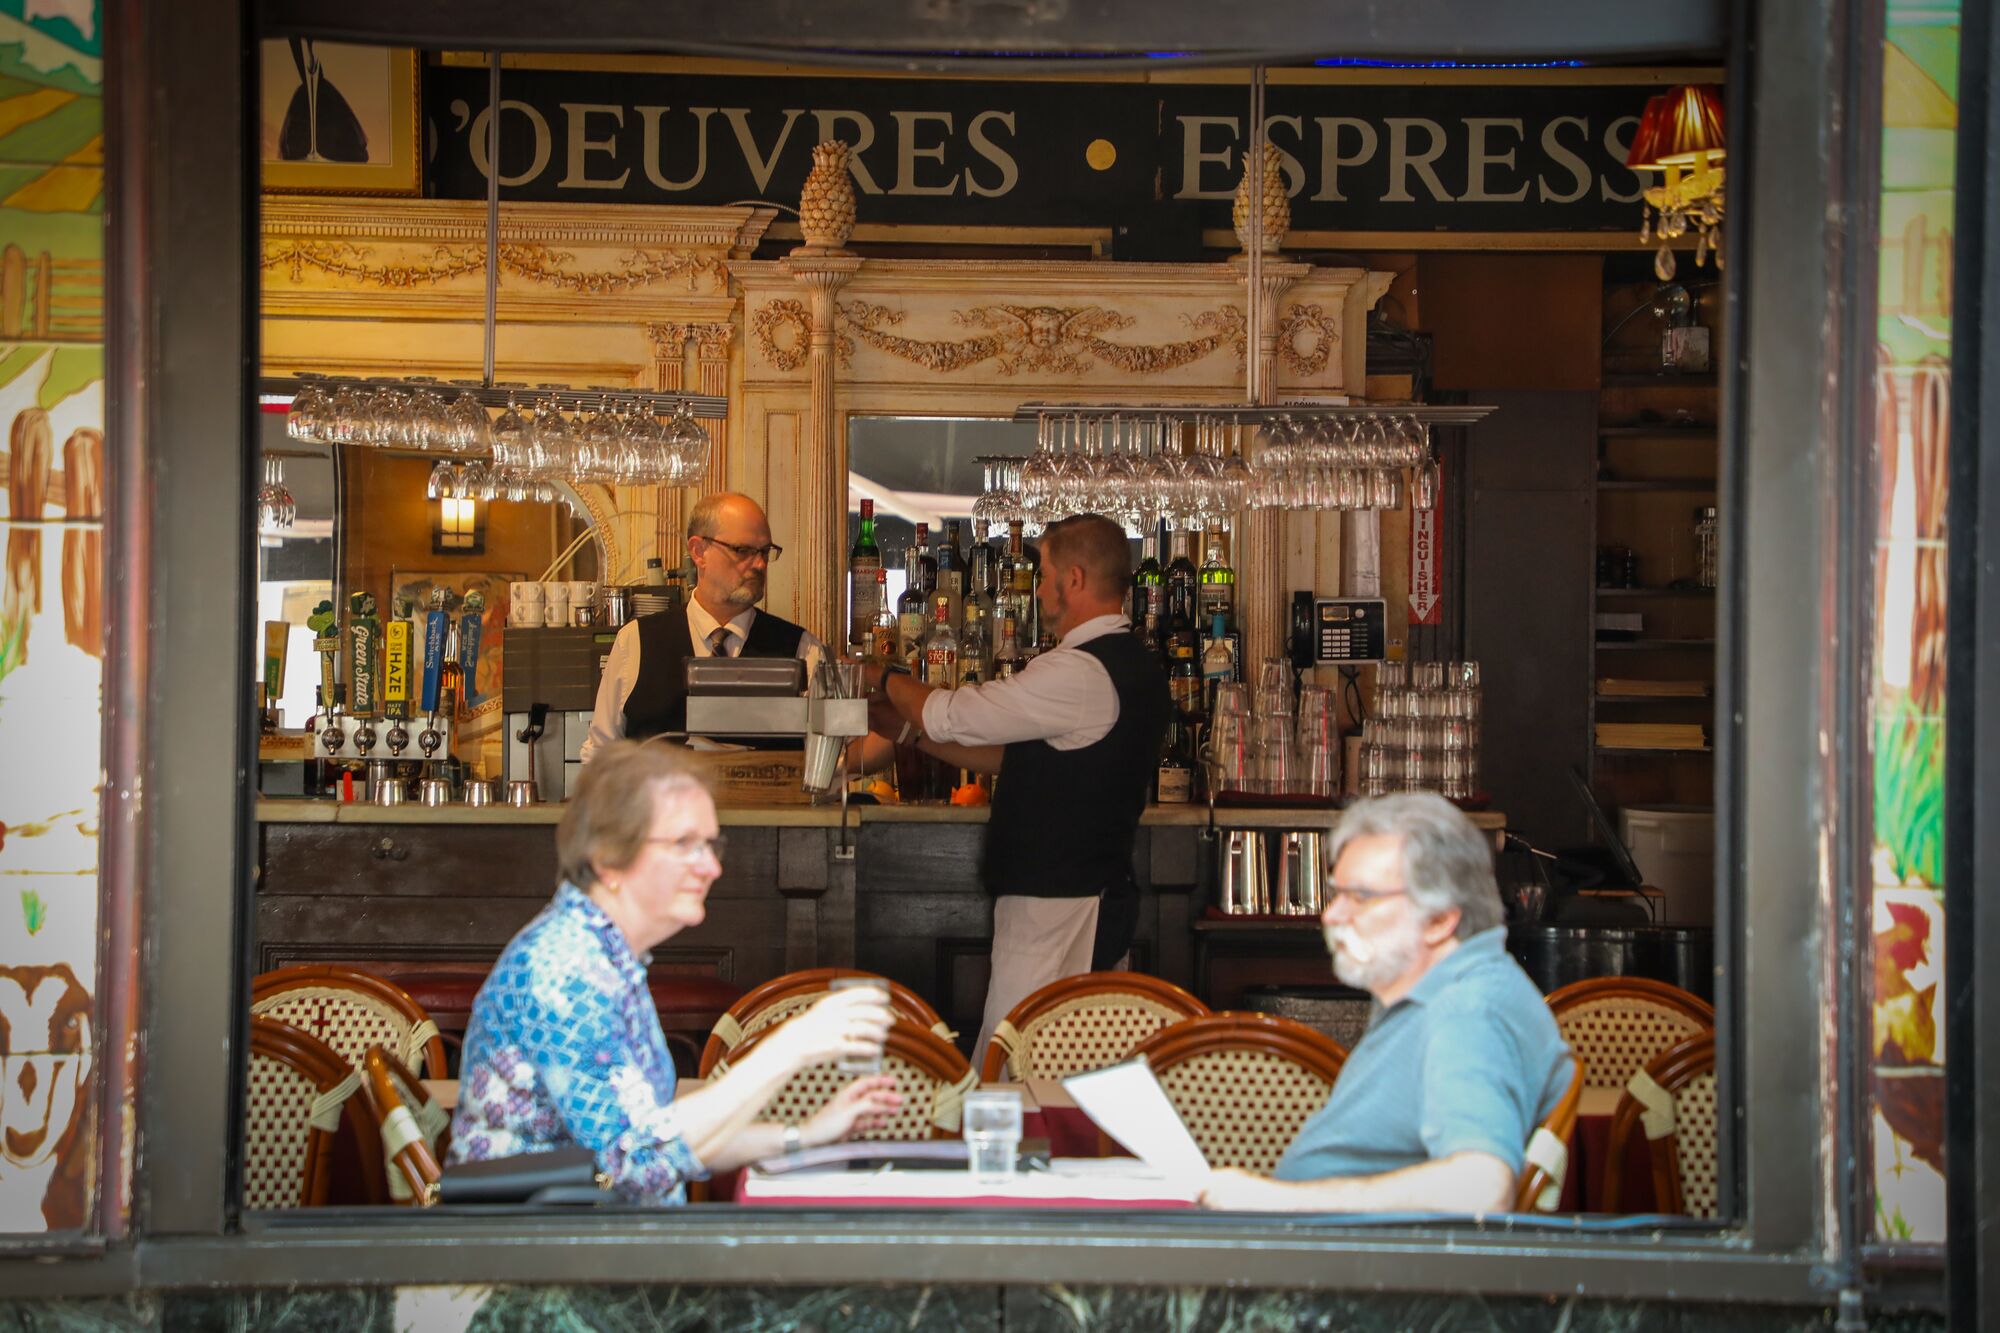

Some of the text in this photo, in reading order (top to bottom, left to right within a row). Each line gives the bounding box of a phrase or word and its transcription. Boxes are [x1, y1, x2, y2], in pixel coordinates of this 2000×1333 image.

[429, 99, 1018, 197] 'OEUVRES
[1417, 510, 1429, 611] TINGUISHER
[351, 625, 370, 706] Green State
[389, 652, 402, 693] HAZE
[387, 707, 401, 716] IPA
